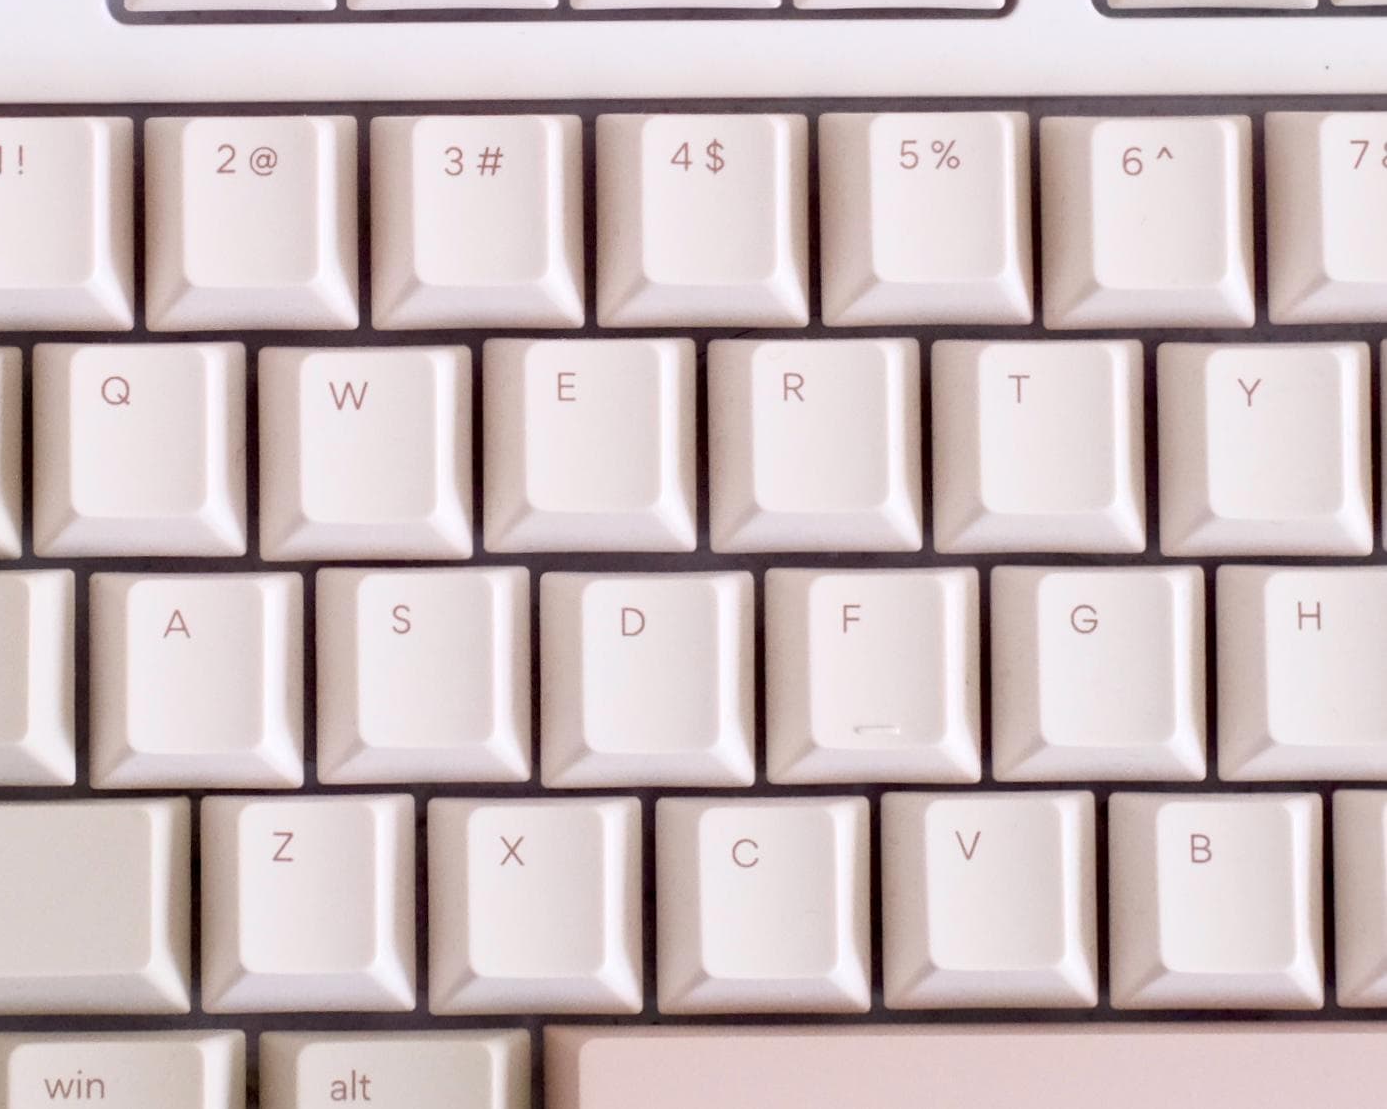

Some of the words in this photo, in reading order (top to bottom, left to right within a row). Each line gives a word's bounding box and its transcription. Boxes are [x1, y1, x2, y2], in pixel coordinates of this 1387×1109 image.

[216, 143, 237, 175] 2
[249, 146, 278, 177] @
[444, 146, 464, 177] 3
[476, 146, 504, 176] #
[670, 141, 693, 172] 4
[705, 138, 726, 175] $
[899, 139, 920, 170] 5
[930, 139, 961, 170] %
[1121, 146, 1144, 177] 6
[1349, 139, 1370, 170] 7
[100, 375, 131, 406] Q
[328, 381, 369, 411] W
[557, 371, 576, 402] E
[782, 372, 805, 402] R
[1007, 374, 1031, 404] T
[1237, 378, 1262, 407] Y
[163, 609, 191, 639] A
[392, 604, 412, 635] S
[620, 606, 646, 637] D
[842, 604, 861, 634] F
[1070, 603, 1099, 635] G
[1297, 601, 1322, 631] H
[272, 831, 294, 863] Z
[500, 836, 525, 867] X
[731, 838, 760, 869] C
[955, 830, 982, 861] V
[1190, 833, 1213, 864] B
[44, 1069, 106, 1100] win
[330, 1069, 372, 1102] alt
